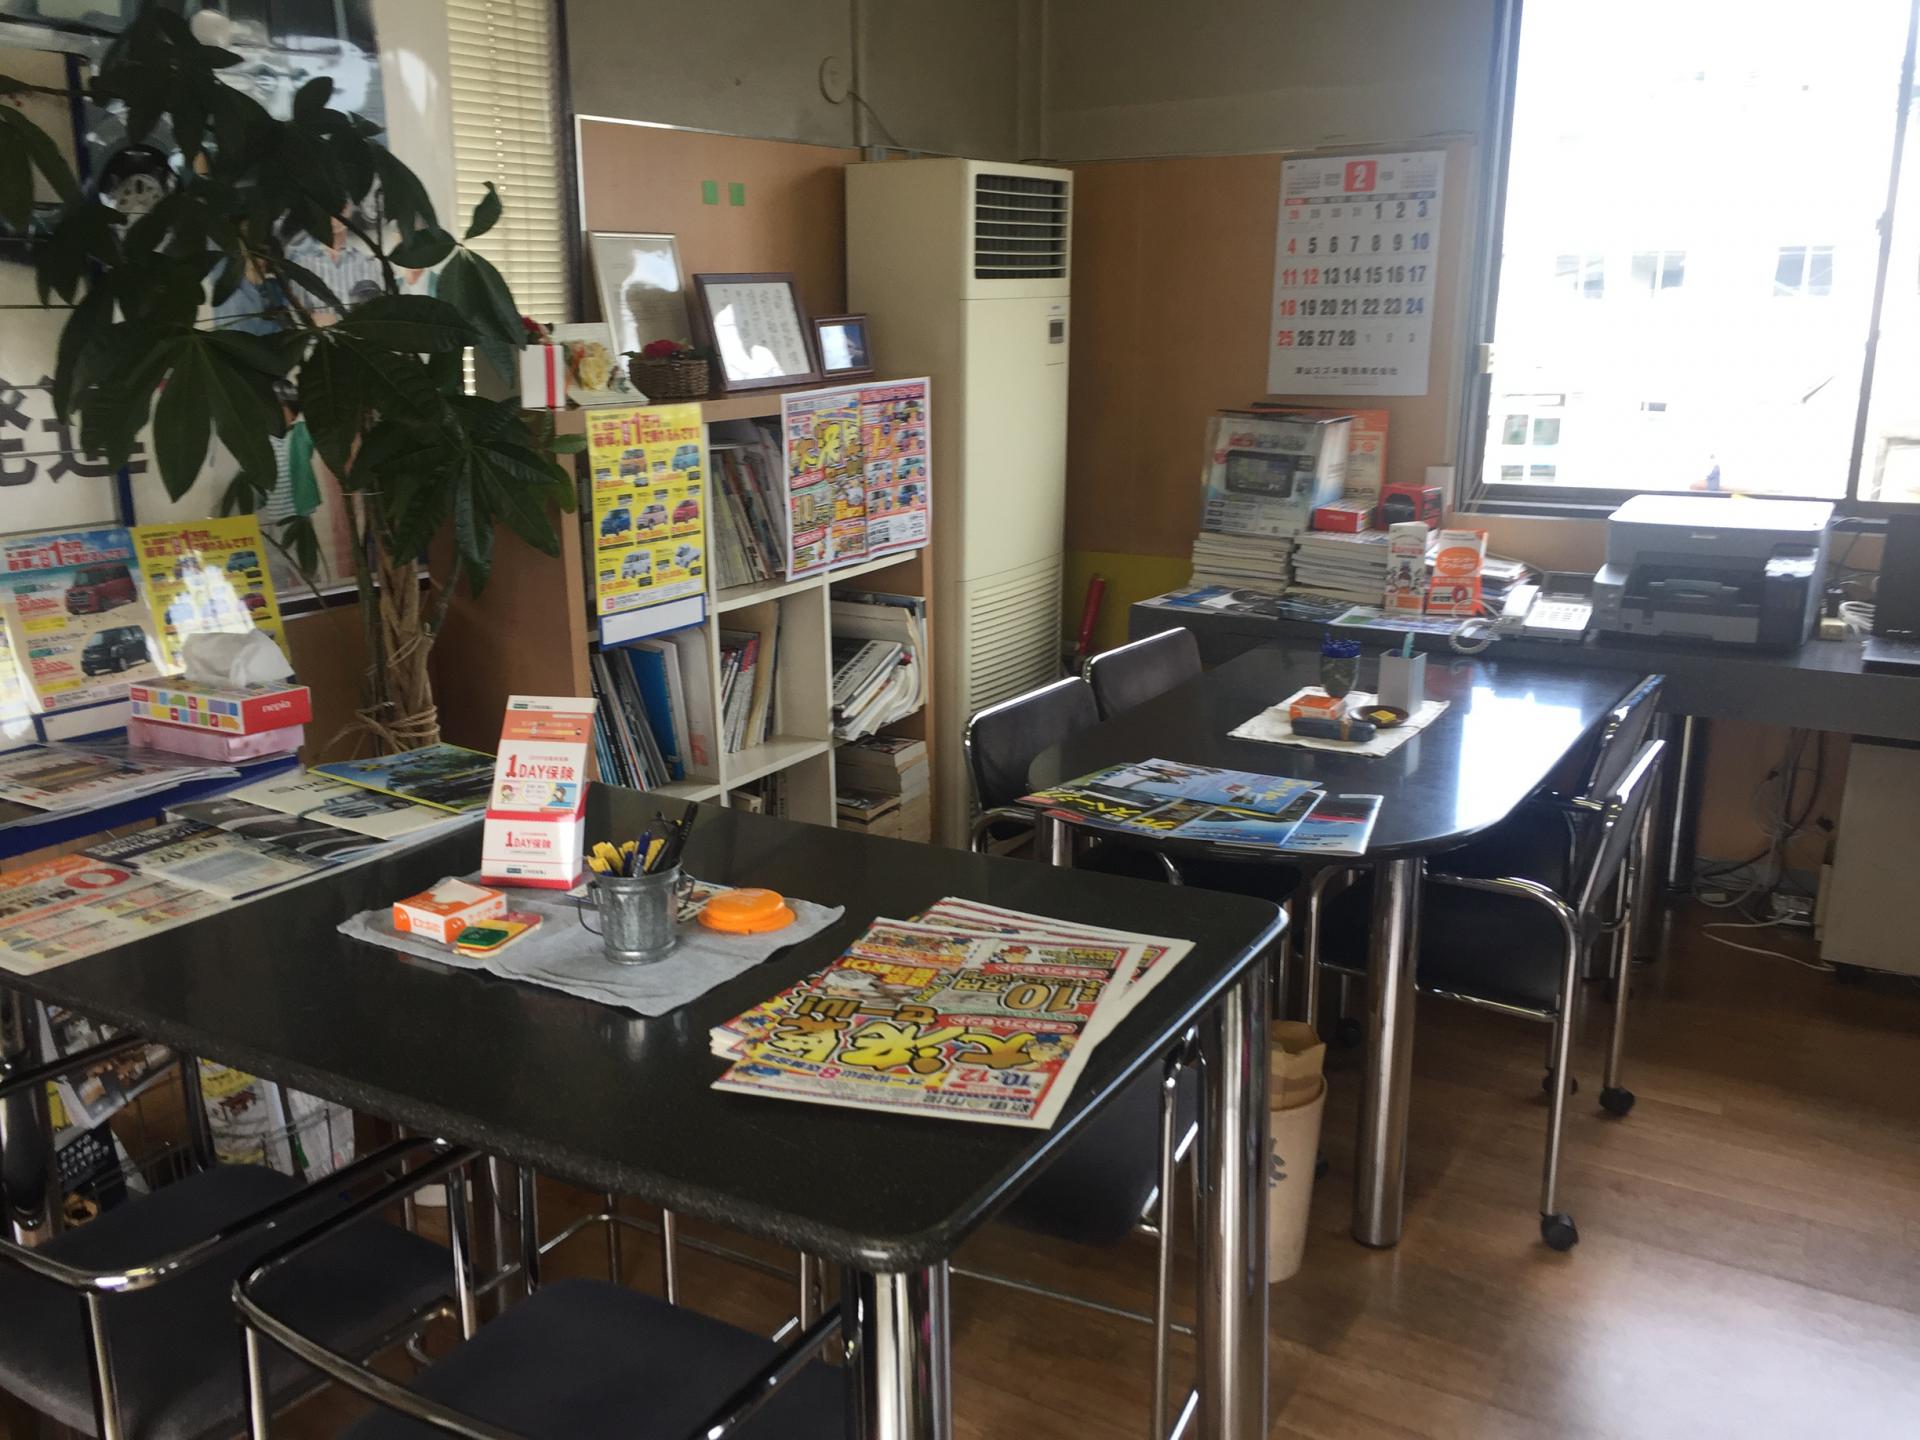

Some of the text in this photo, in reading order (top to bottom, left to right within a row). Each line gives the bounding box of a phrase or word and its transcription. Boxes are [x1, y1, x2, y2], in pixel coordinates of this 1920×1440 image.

[1353, 164, 1366, 189] 2
[1374, 204, 1382, 219] 1
[1396, 202, 1405, 218] 2
[1417, 200, 1428, 217] 3
[1288, 232, 1429, 254] 4 5 6 7 8 9 10
[1282, 265, 1426, 285] 11 12 13 14 15 16 17
[1281, 298, 1423, 316] 18 19 20 21 22 23 24
[1278, 331, 1293, 346] 25
[1298, 330, 1314, 346] 26
[1318, 330, 1335, 346] 27
[1339, 330, 1356, 346] 28
